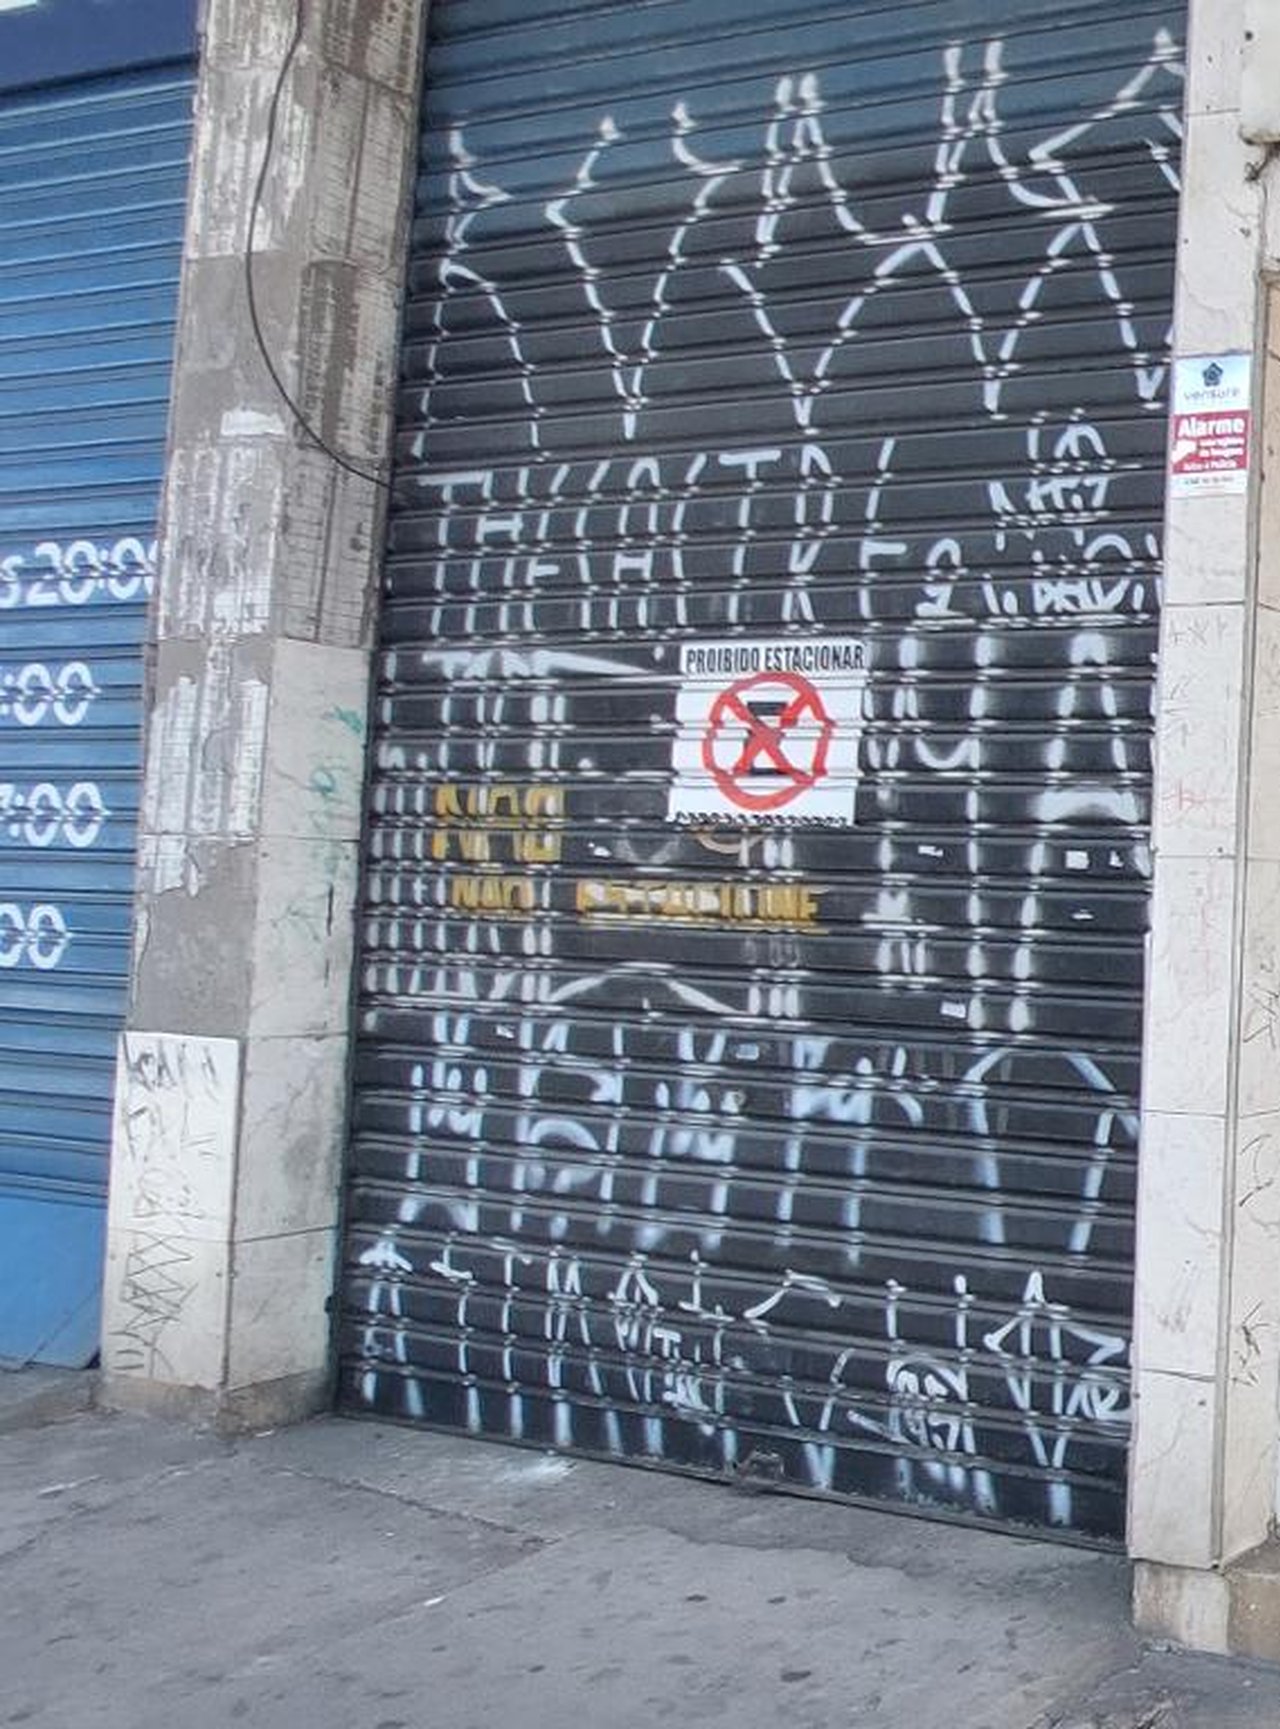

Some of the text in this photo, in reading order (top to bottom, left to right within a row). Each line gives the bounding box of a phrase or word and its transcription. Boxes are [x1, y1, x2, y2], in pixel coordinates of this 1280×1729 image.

[1178, 417, 1245, 438] Alarme
[686, 645, 865, 673] PROIBIDO ESTACIONAR
